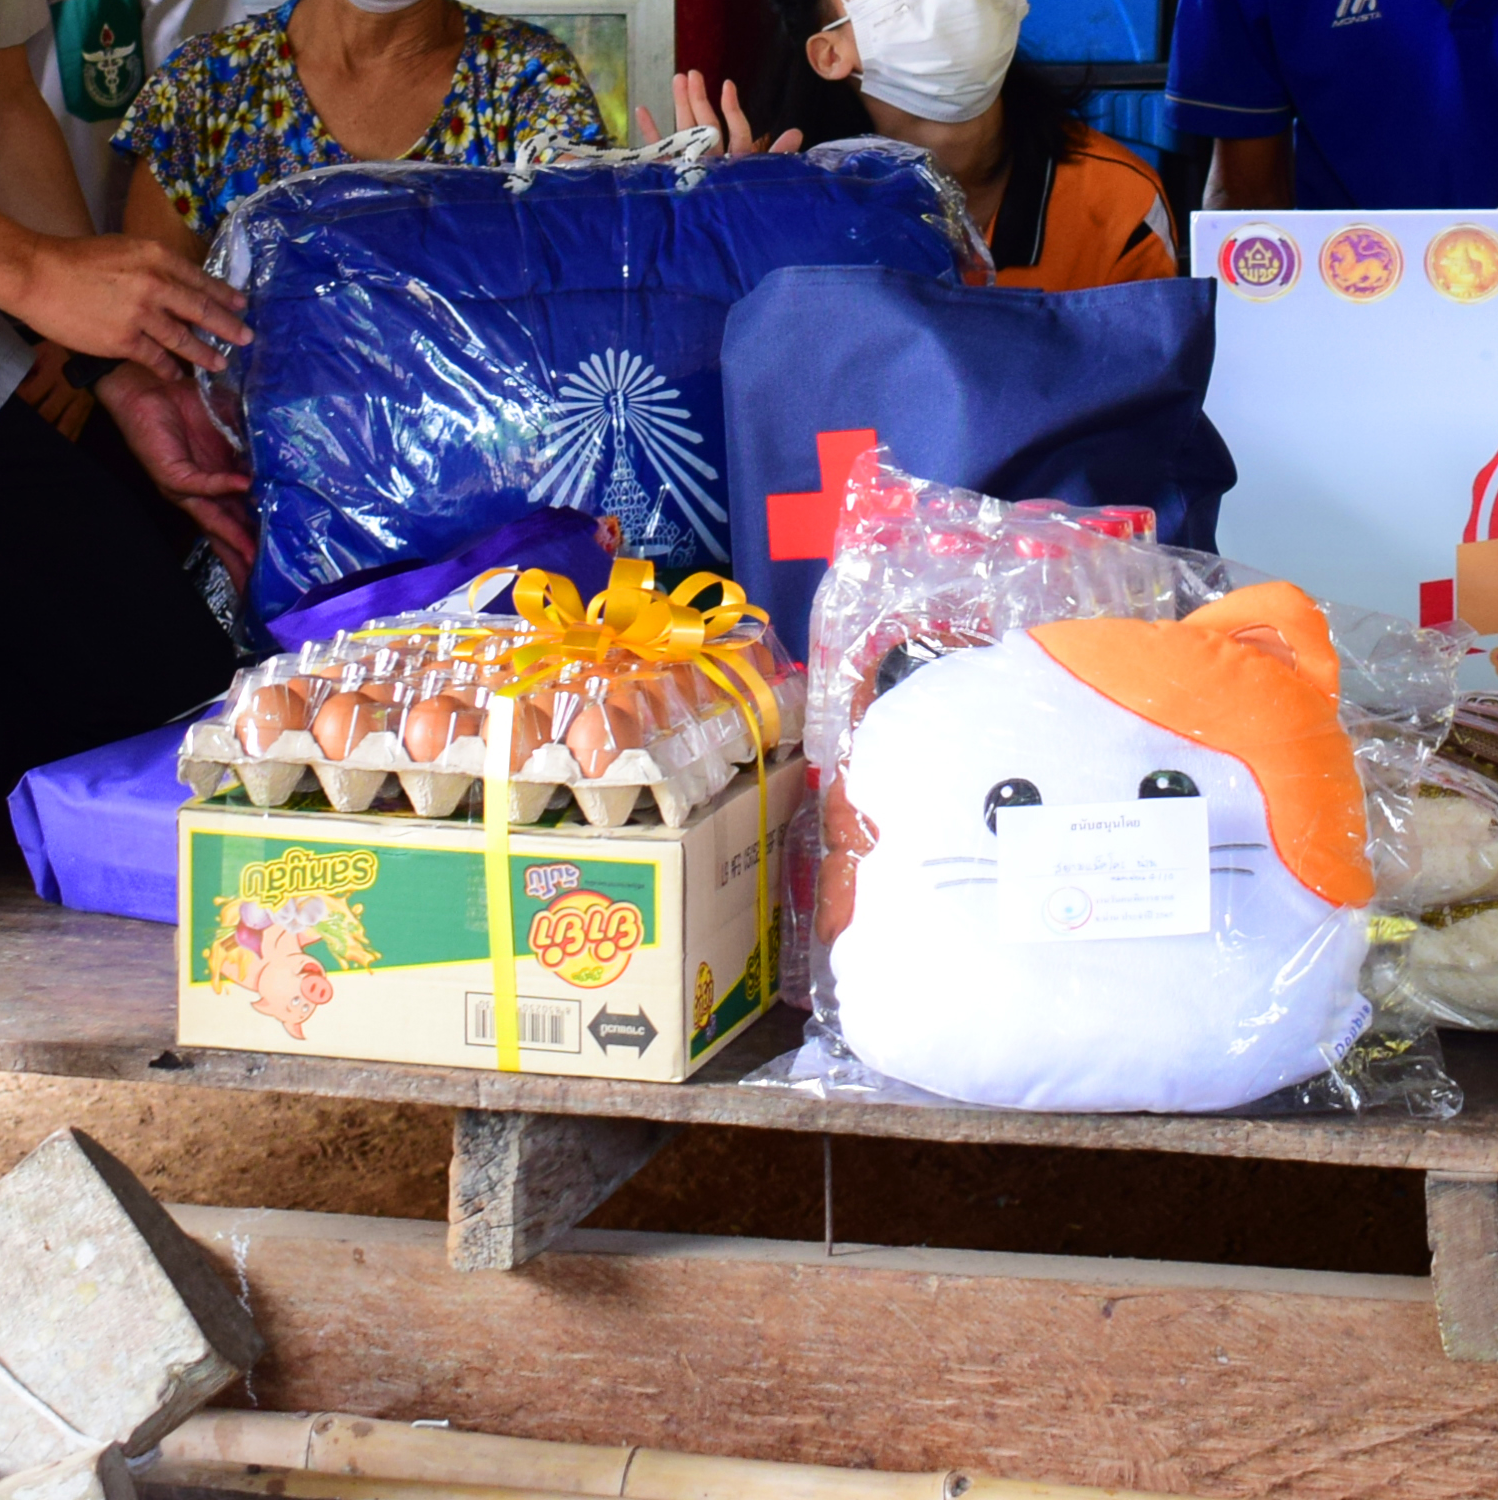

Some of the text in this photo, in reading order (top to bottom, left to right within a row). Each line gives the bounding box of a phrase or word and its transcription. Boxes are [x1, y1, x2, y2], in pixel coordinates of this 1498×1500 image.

[1070, 815, 1141, 833] สนับสนุนโดย
[240, 848, 376, 907] รสหมูสับ
[526, 864, 579, 898] จัมโบ้
[530, 904, 642, 970] ยำยำ
[1334, 1004, 1371, 1058] Double
